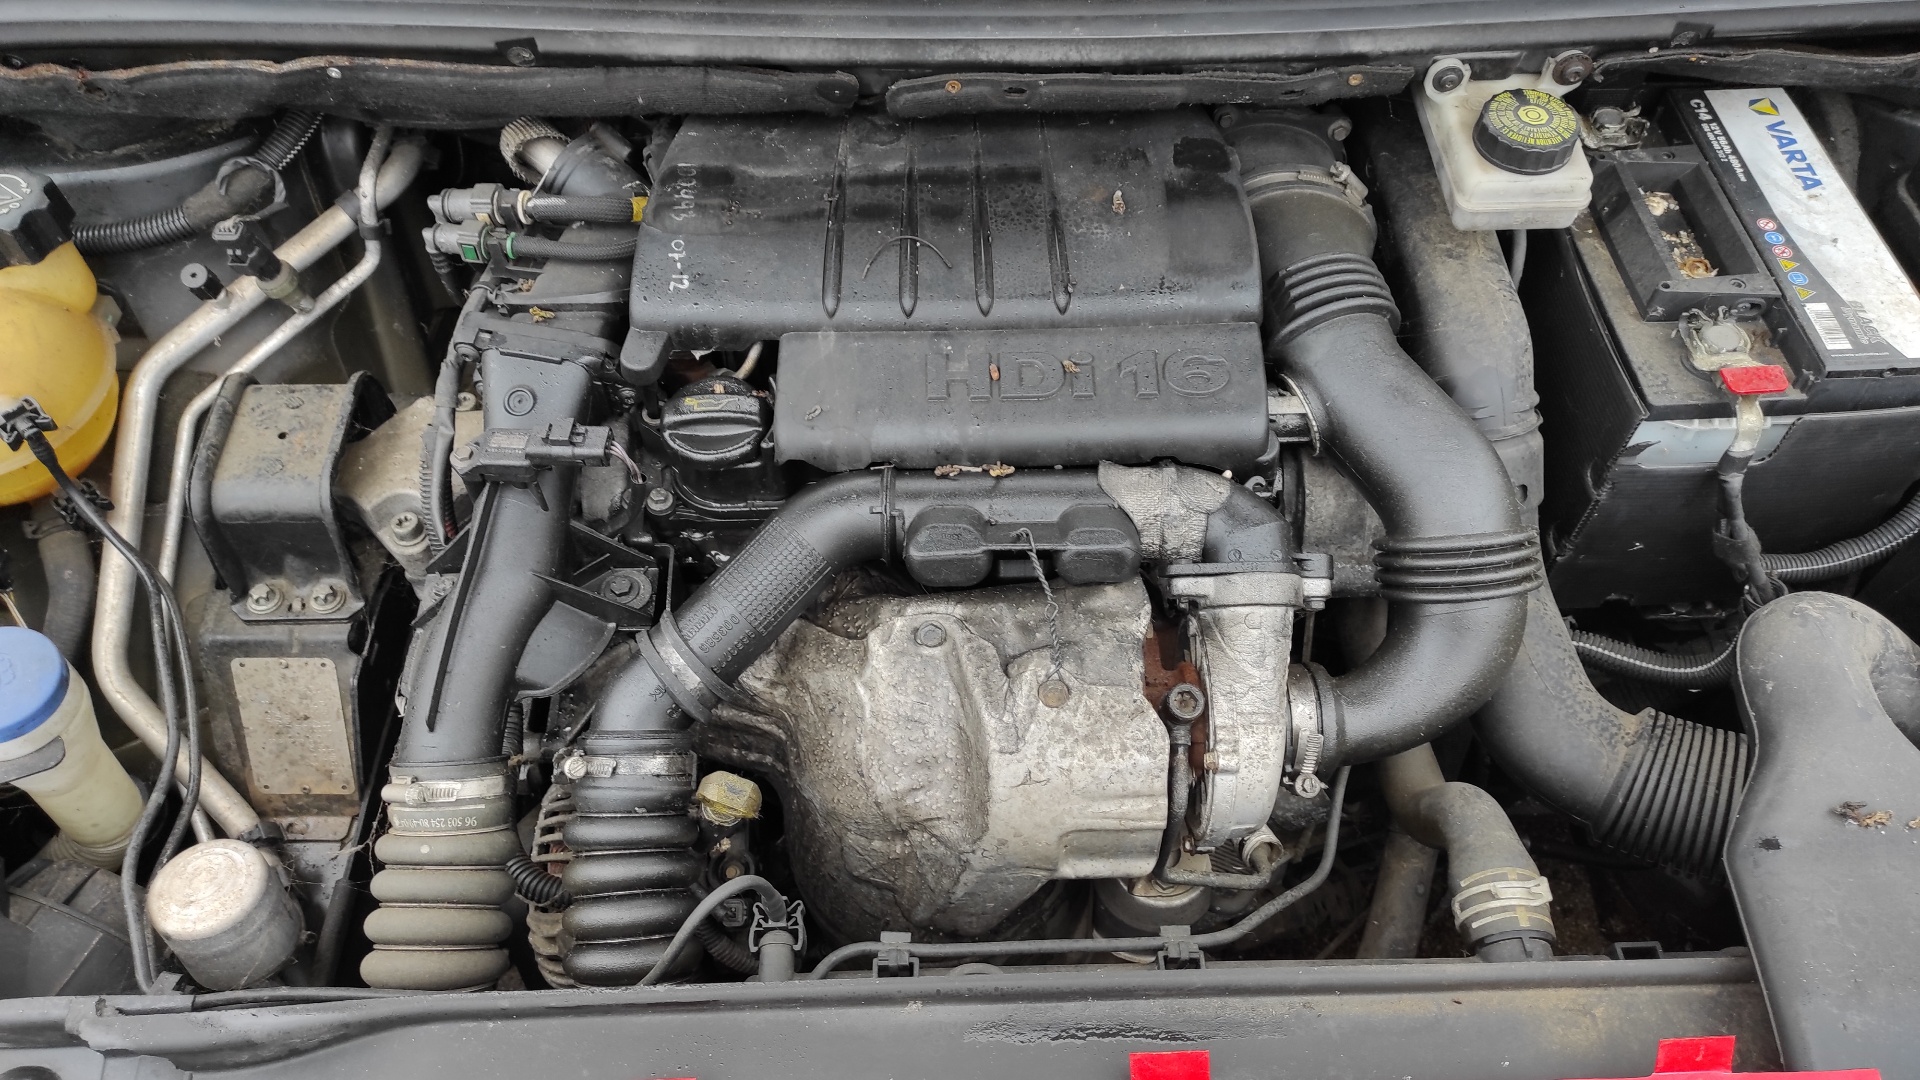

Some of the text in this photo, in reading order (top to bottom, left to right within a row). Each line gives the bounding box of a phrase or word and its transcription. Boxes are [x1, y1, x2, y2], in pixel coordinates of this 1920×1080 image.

[1690, 99, 1713, 121] C14
[1708, 122, 1723, 136] 12V
[1716, 136, 1732, 154] 56Ah
[1765, 120, 1823, 191] VARTA
[926, 350, 1231, 401] HDi 16
[430, 818, 445, 828] 254
[447, 816, 463, 828] 503
[464, 816, 478, 827] 96
